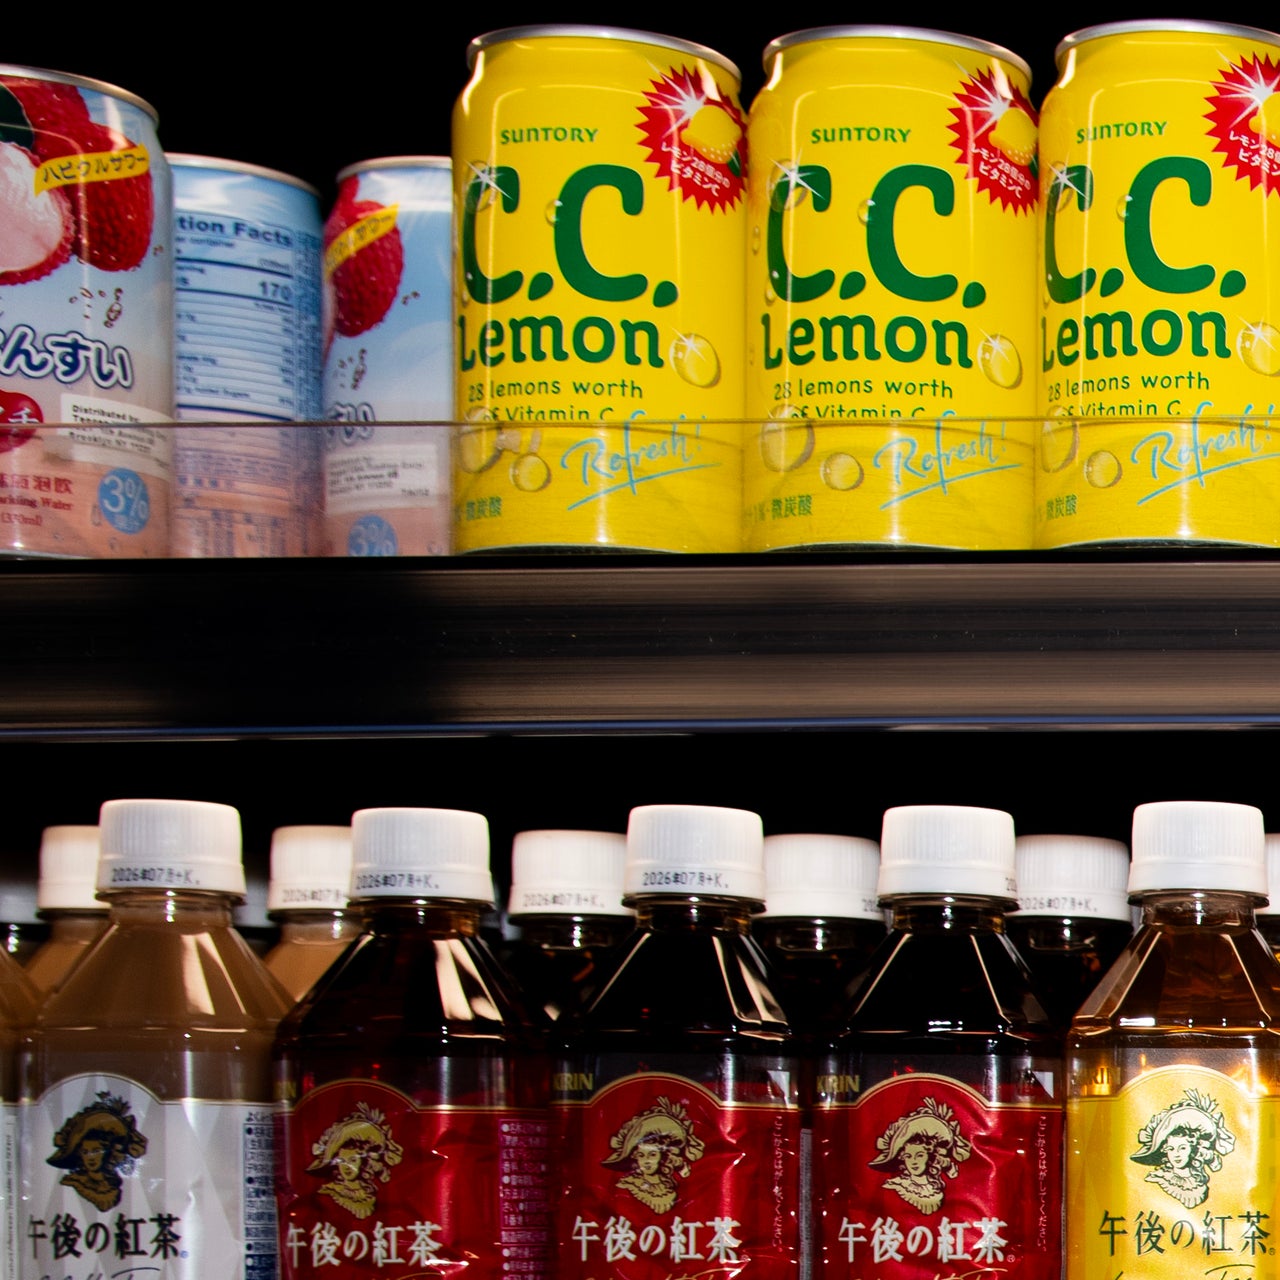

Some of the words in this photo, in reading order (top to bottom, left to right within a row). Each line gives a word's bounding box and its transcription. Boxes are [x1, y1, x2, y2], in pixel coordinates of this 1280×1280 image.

[500, 127, 598, 145] SUNTORY
[810, 126, 911, 145] SUNTORY
[1077, 120, 1168, 144] SUNTORY
[234, 216, 293, 247] Facts
[260, 279, 292, 300] 170
[458, 314, 664, 371] Lemon
[762, 312, 973, 371] Lemon
[1040, 308, 1232, 374] Lemon
[491, 379, 560, 397] lemons
[573, 379, 643, 398] worth
[799, 378, 874, 396] lemons
[884, 378, 953, 398] worth
[1066, 374, 1129, 397] lemons
[1142, 372, 1210, 390] worth
[28, 1213, 181, 1260] 午後の紅茶
[287, 1220, 442, 1268] 午後の紅茶
[572, 1215, 740, 1263] 午後の紅茶
[838, 1217, 1008, 1263] 午後の紅茶
[1100, 1210, 1270, 1258] 午後の紅茶
